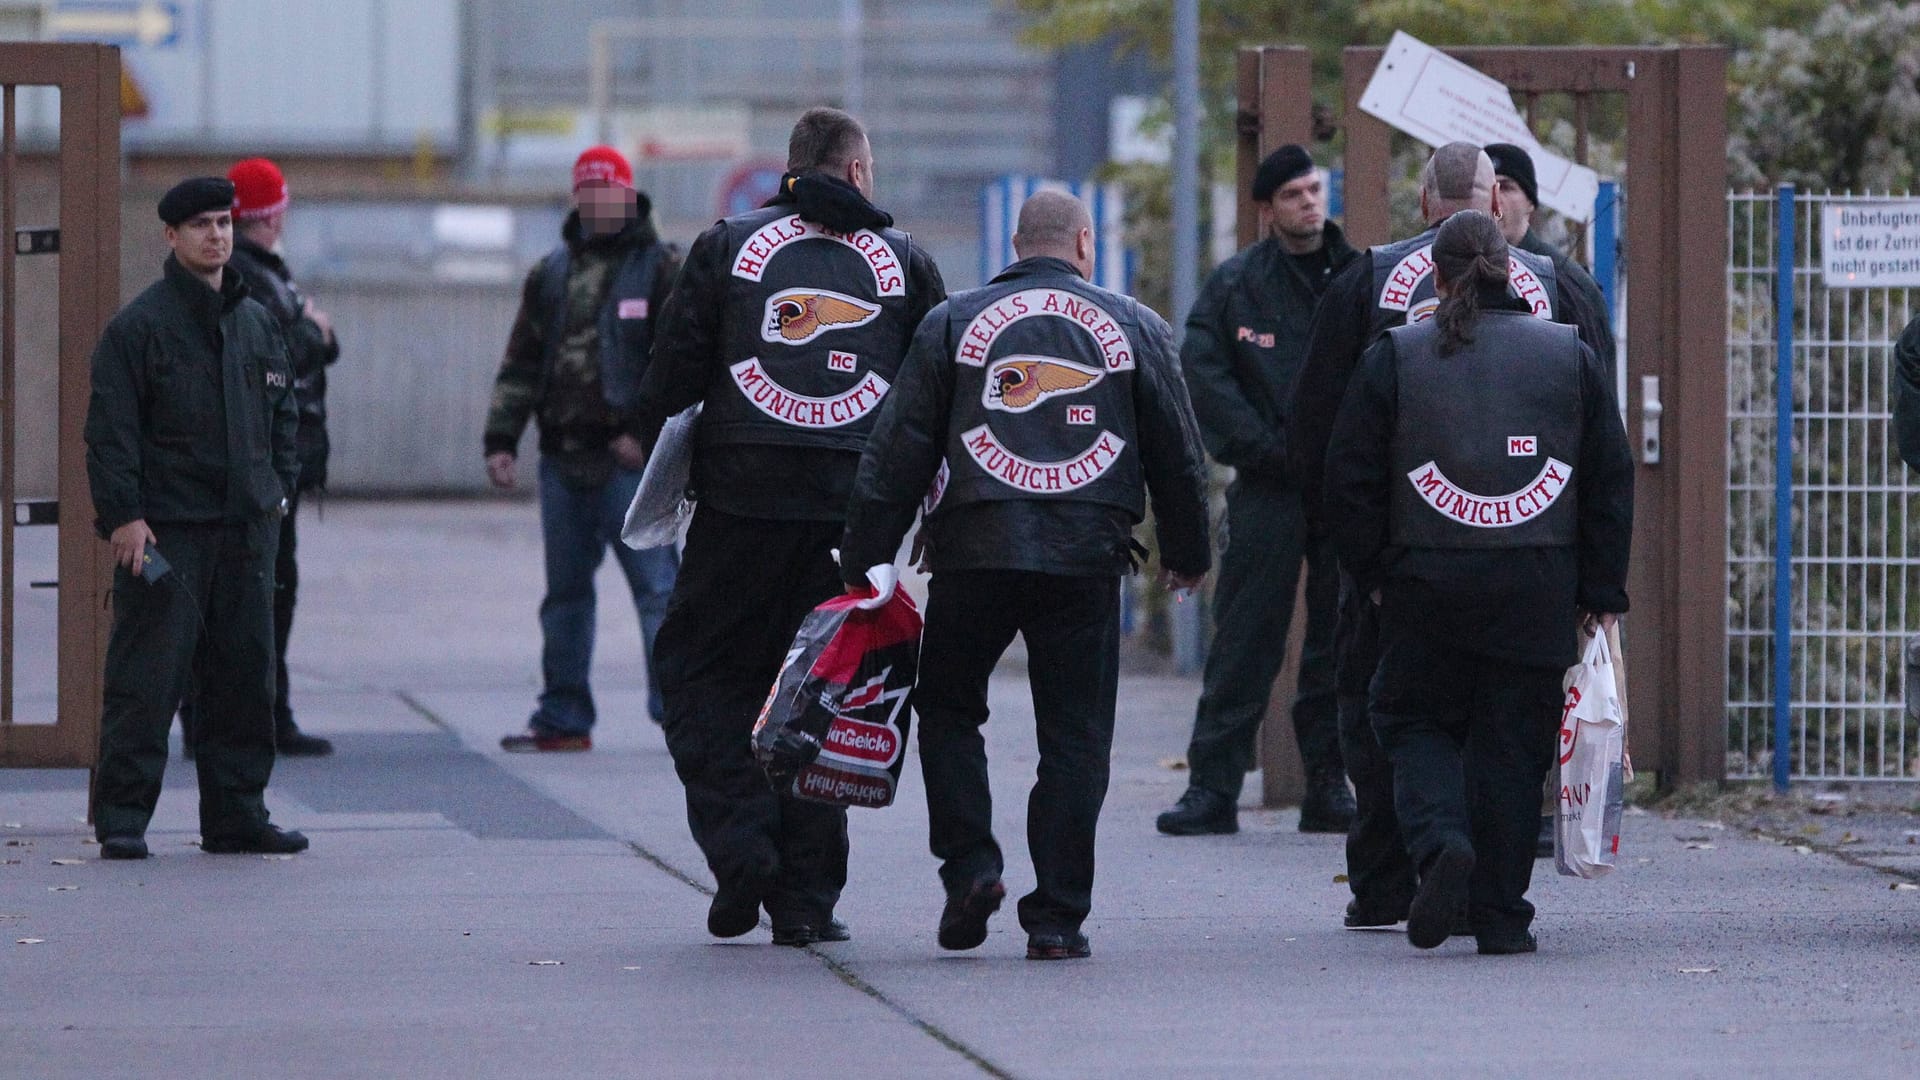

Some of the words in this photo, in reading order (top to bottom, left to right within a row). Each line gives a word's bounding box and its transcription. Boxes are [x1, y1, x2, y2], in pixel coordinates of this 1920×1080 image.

[737, 216, 806, 277] HELLS
[1832, 259, 1867, 273] nicht
[1870, 259, 1920, 278] gestatt
[1833, 236, 1852, 251] ist
[1856, 235, 1880, 251] der
[1885, 233, 1920, 251] Zutri
[1385, 251, 1434, 307] HELL
[960, 295, 1029, 363] HELLS
[1041, 292, 1131, 369] ANGELS
[830, 353, 854, 369] MC
[737, 362, 826, 425] MUNICH
[830, 377, 881, 423] CITY
[1069, 408, 1093, 422] MC
[968, 430, 1063, 490] MUNICH
[1066, 435, 1117, 486] CITY
[1510, 439, 1534, 453] MC
[1415, 467, 1513, 525] MUNICH
[1515, 463, 1565, 518] CITY
